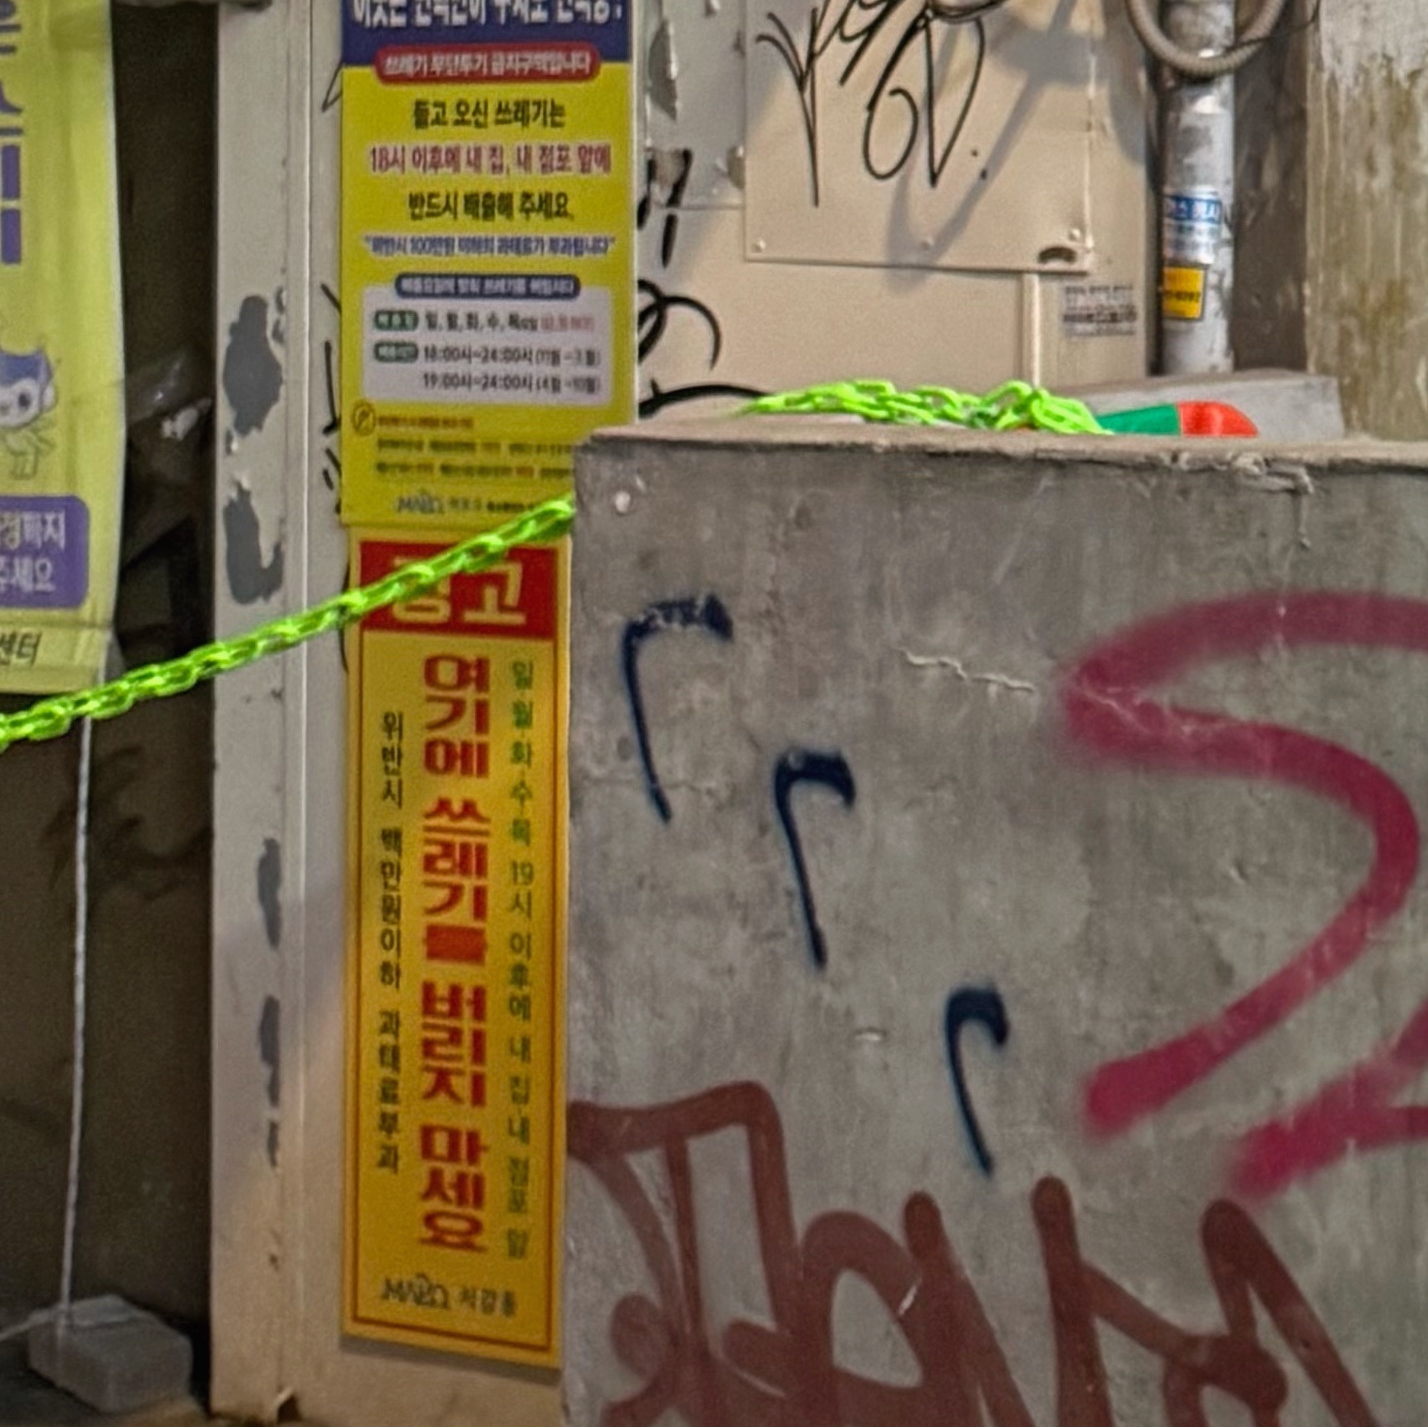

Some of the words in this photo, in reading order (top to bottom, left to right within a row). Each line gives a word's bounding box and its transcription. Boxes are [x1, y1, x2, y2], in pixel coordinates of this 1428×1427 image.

[413, 98, 448, 130] 들고
[453, 98, 489, 128] 오신
[494, 97, 567, 128] 쓰레기는
[408, 190, 459, 221] 반드시
[422, 654, 491, 780] 여기에
[420, 980, 487, 1110] 버리지
[418, 1123, 488, 1254] 마세요
